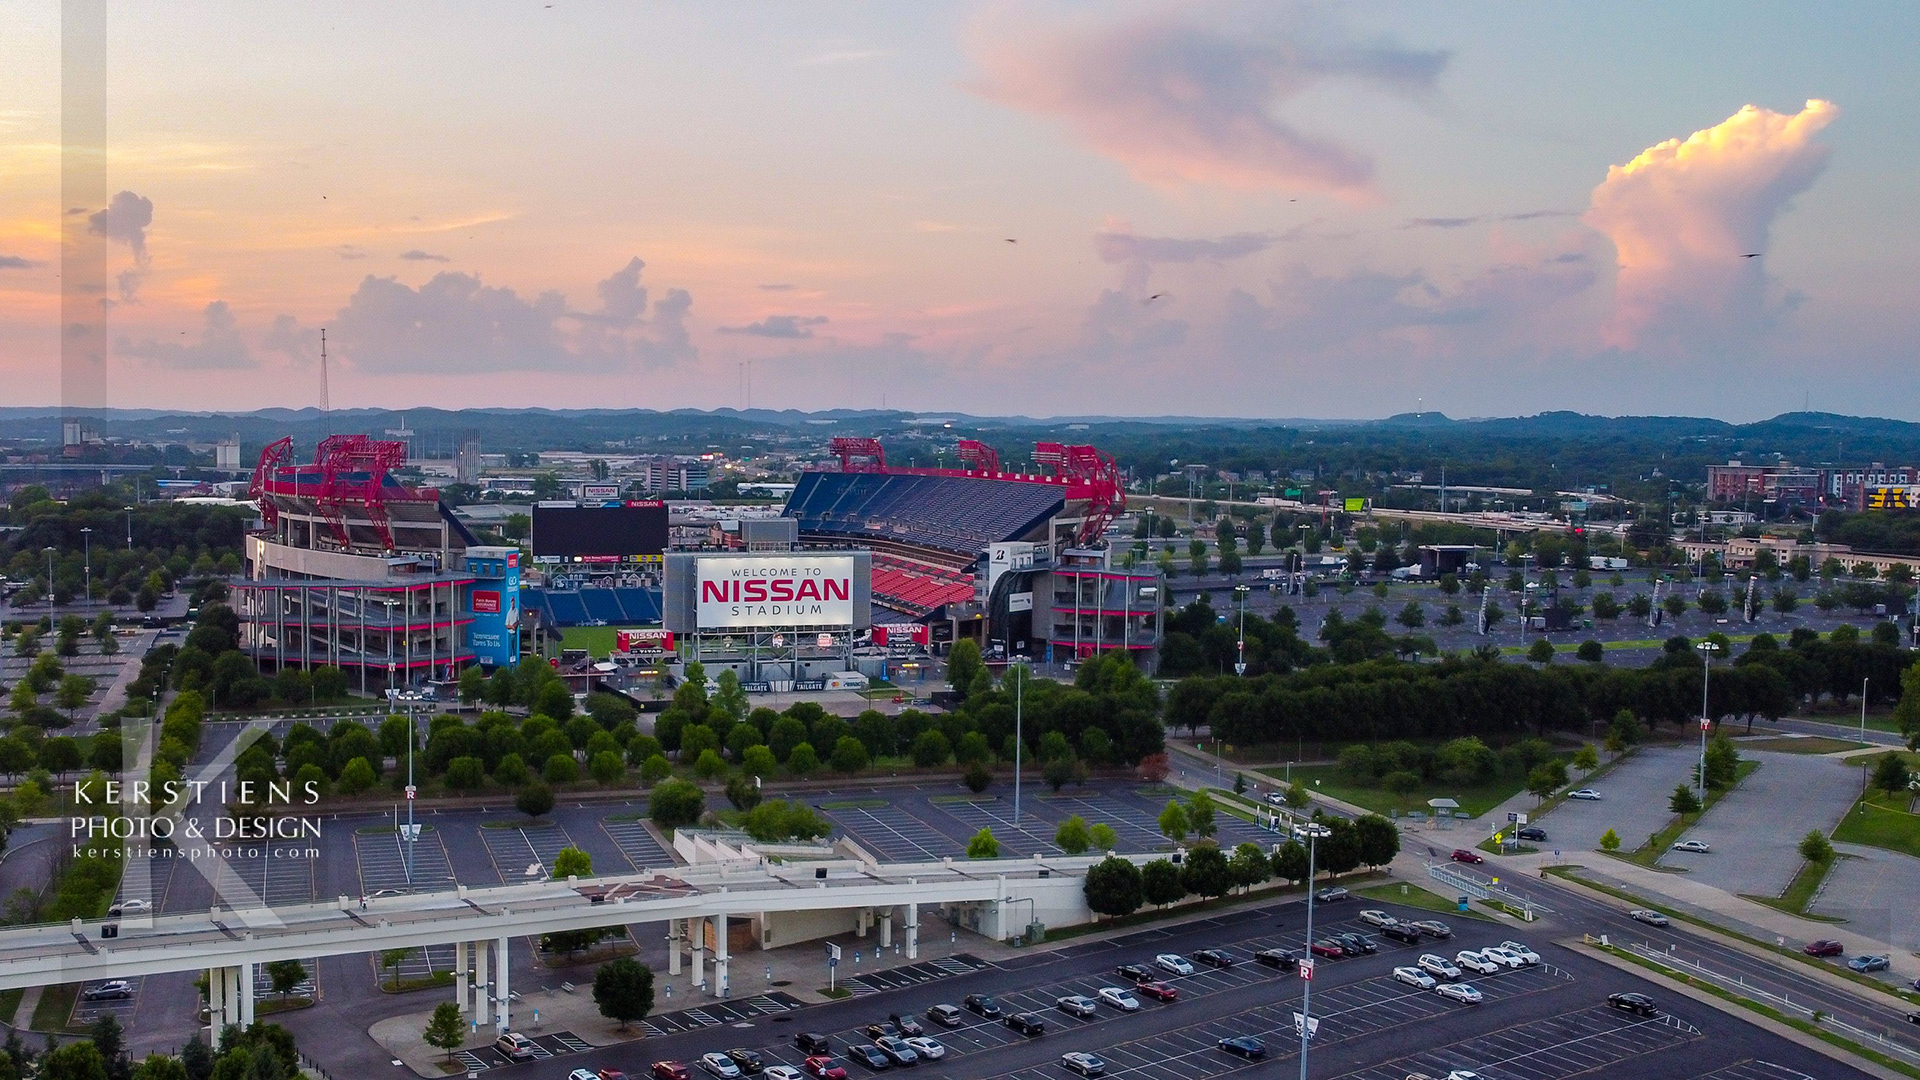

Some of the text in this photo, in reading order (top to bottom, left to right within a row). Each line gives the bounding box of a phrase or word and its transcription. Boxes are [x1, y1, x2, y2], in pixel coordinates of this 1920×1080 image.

[732, 568, 821, 577] WELCOME TO
[703, 579, 849, 603] NISSAN
[732, 605, 822, 616] STADIUM
[886, 626, 922, 634] NISSAN
[629, 632, 667, 640] NISSAN
[1077, 646, 1093, 658] 10
[407, 791, 414, 799] R
[1300, 967, 1309, 979] R
